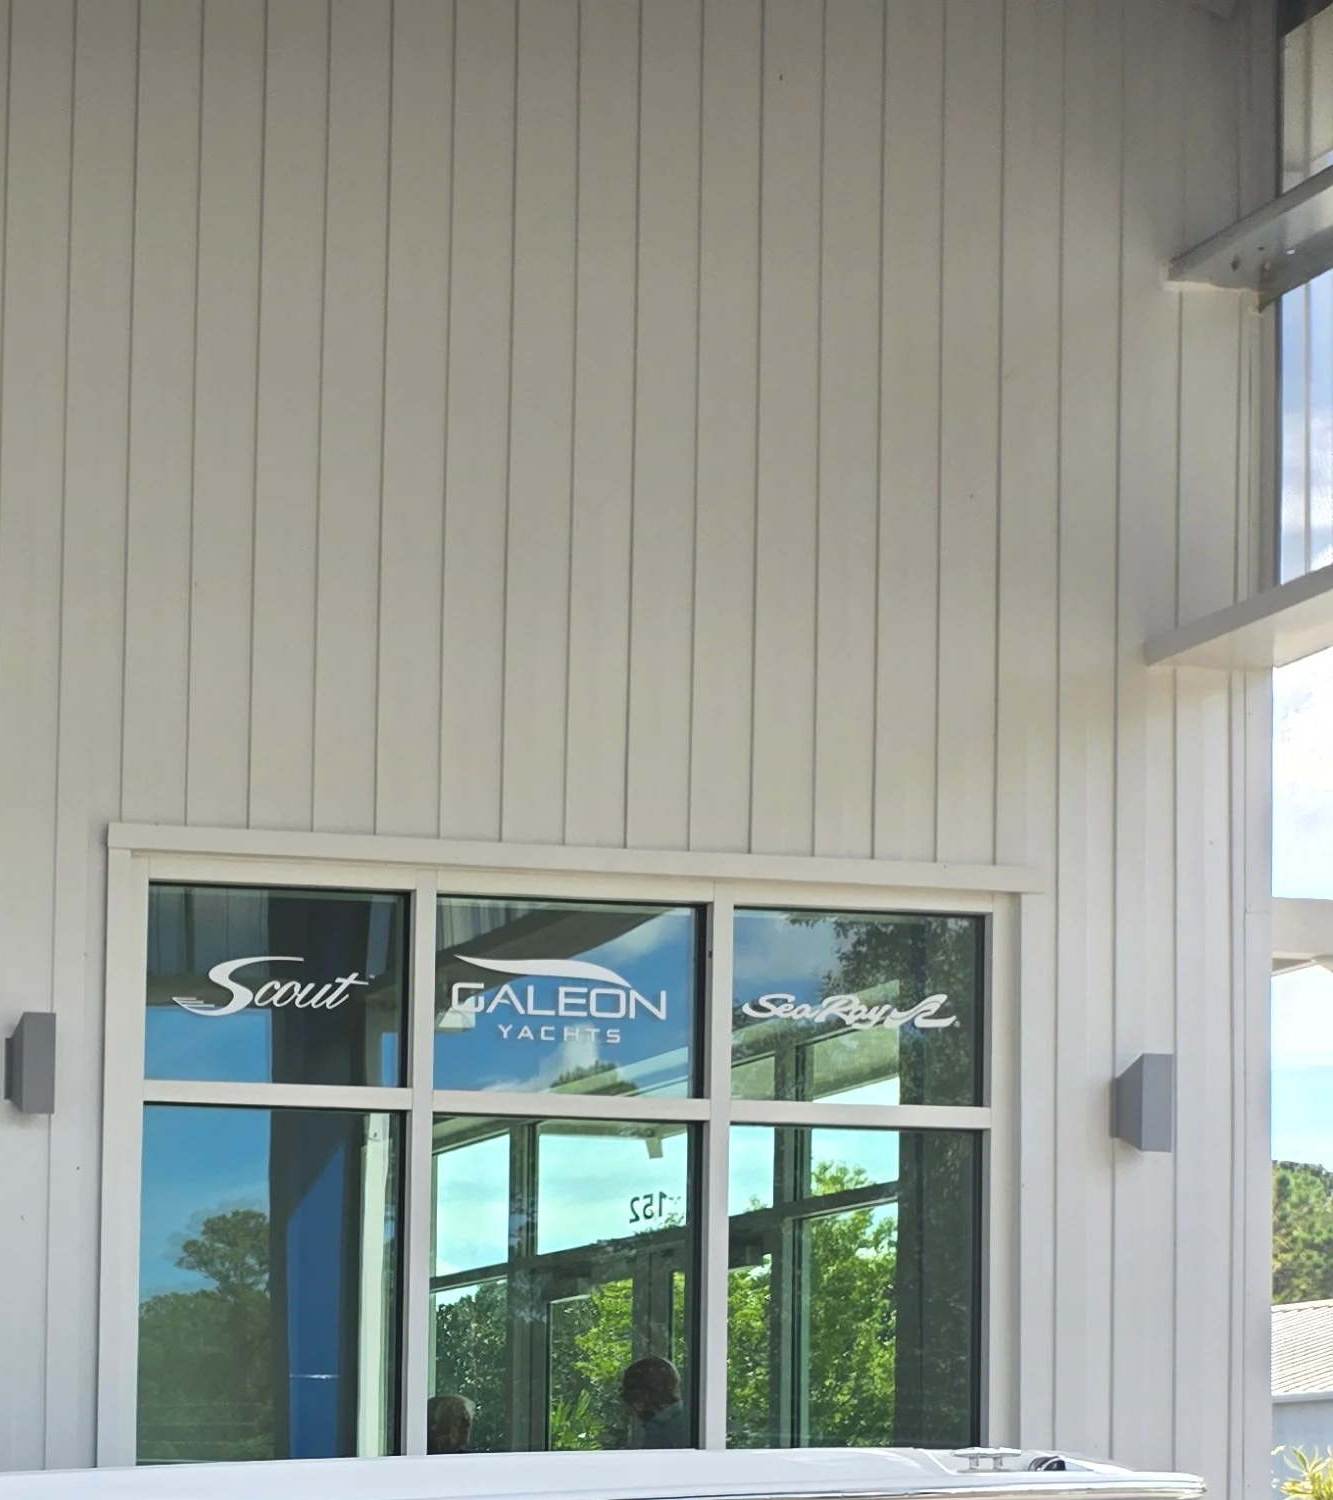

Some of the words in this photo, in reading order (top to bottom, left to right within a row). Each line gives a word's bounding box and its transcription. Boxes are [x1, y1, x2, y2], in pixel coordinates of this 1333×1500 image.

[172, 956, 369, 1016] Scout
[451, 982, 667, 1021] GALEON
[497, 1024, 621, 1043] YACHTS
